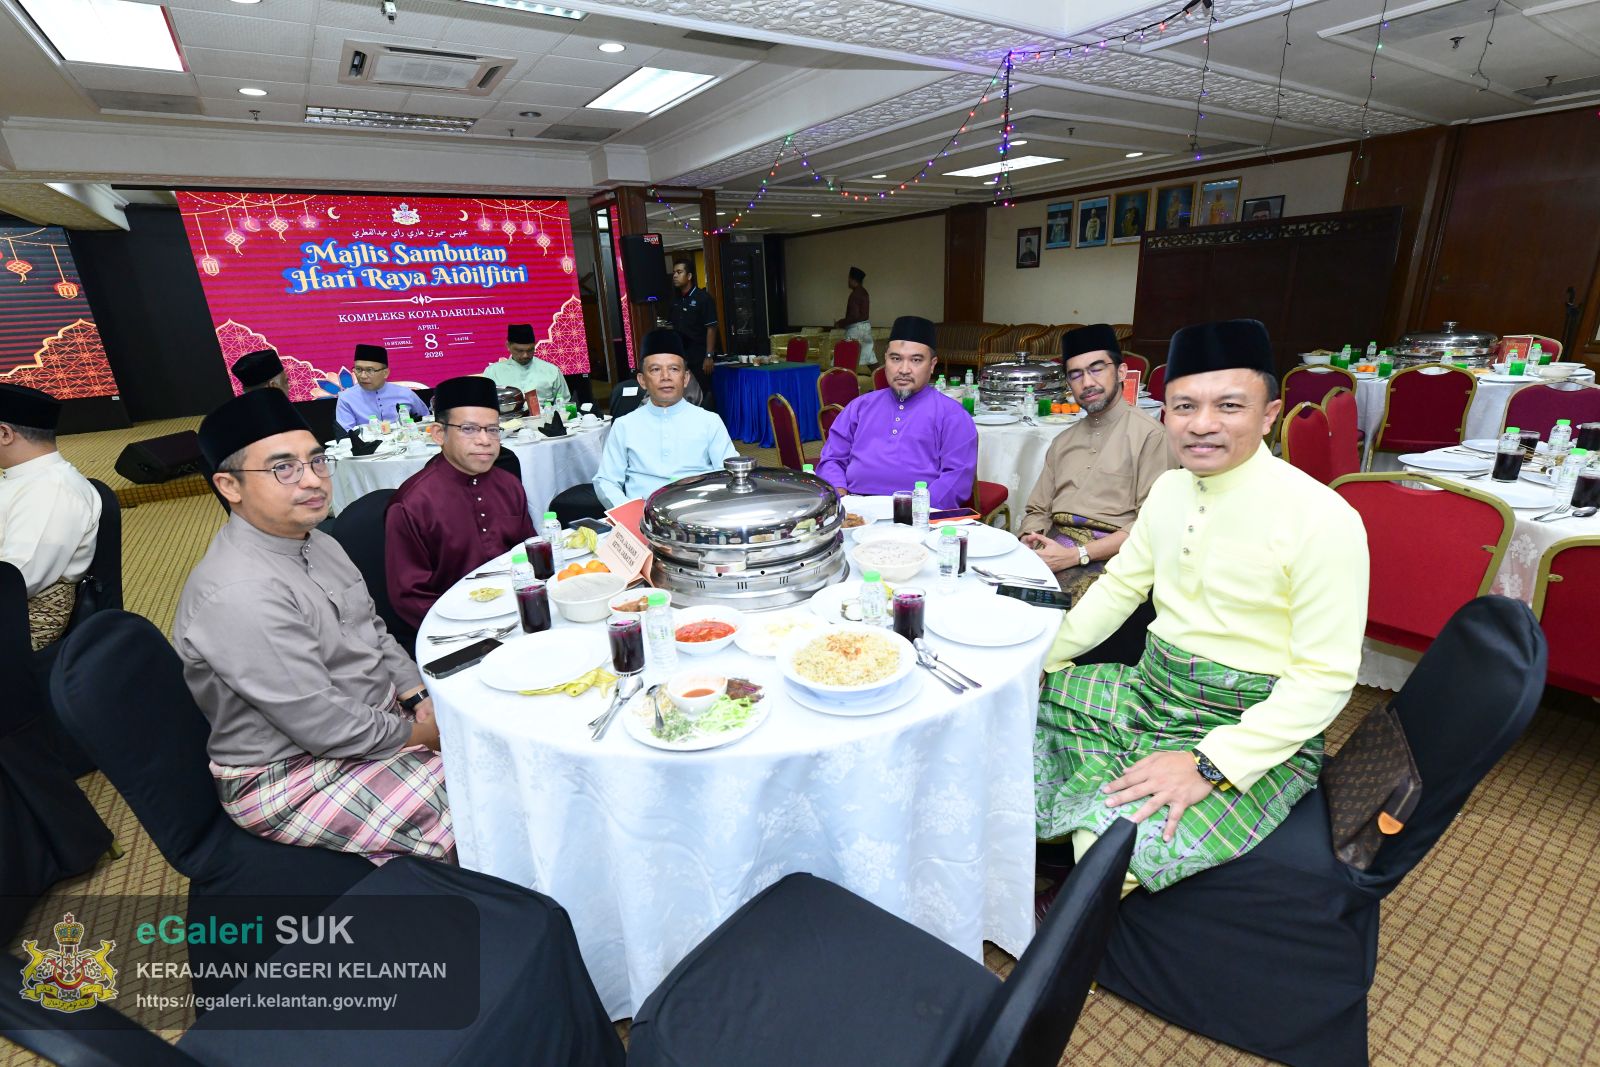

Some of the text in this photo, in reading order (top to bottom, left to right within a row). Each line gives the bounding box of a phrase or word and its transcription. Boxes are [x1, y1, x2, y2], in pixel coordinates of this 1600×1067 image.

[306, 243, 507, 268] Majlis Sambutan
[291, 264, 526, 293] Hari Raya Aidilfitri
[338, 307, 505, 323] KOMPLEKS KOTA DARULNAIM
[424, 333, 439, 350] 8
[424, 351, 444, 359] 2026
